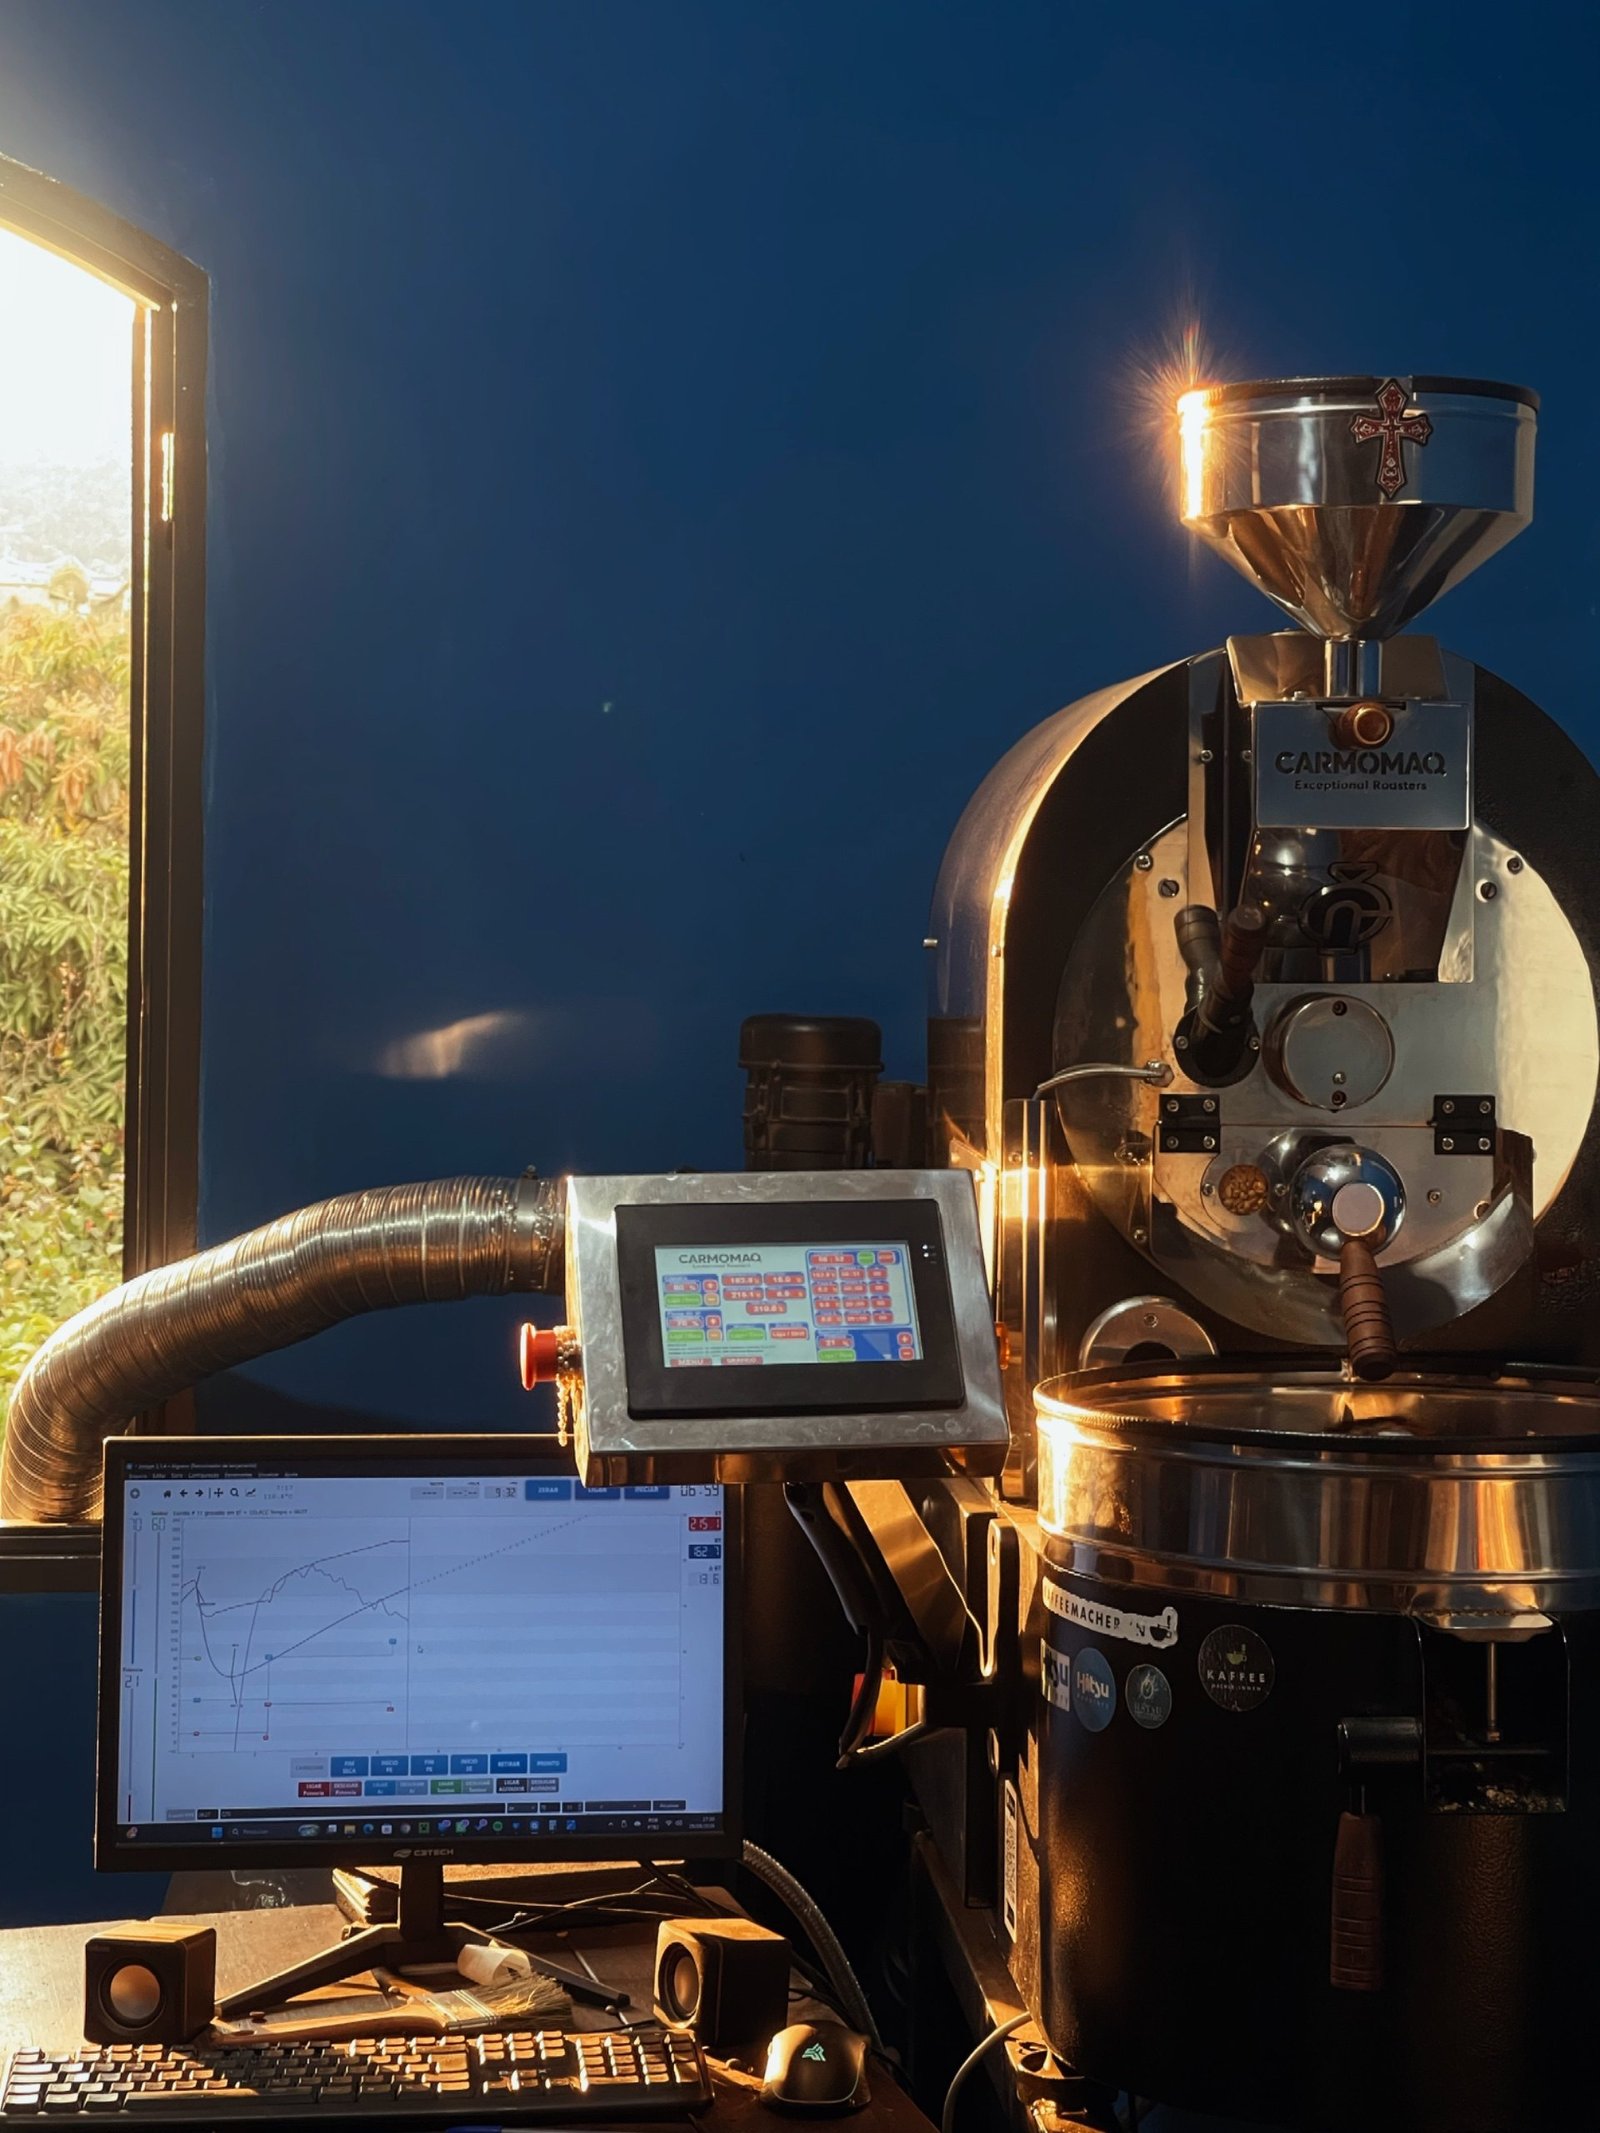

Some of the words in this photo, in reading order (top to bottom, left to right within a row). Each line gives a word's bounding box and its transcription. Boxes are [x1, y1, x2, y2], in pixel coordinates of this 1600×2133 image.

[1275, 751, 1448, 778] CARMOMAQ
[1294, 779, 1369, 792] Exceptional
[1373, 780, 1427, 791] Roasters
[678, 1253, 762, 1265] CARMOMAQ
[1044, 1585, 1120, 1629] FFEEMACHER
[1207, 1669, 1265, 1683] KAFFEE
